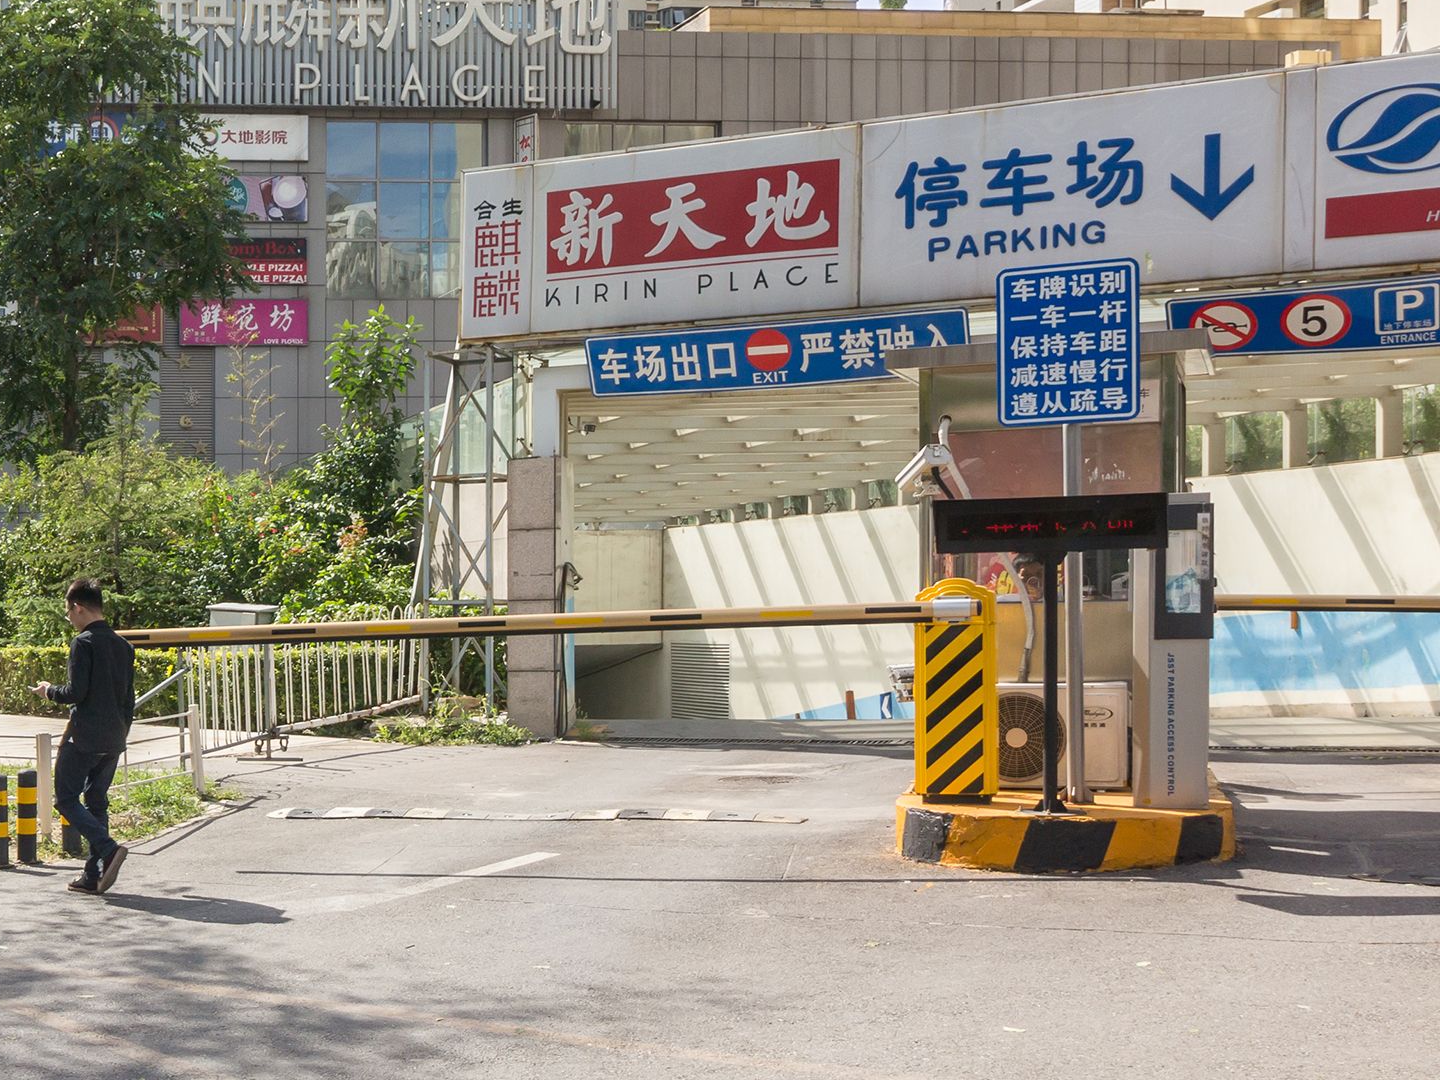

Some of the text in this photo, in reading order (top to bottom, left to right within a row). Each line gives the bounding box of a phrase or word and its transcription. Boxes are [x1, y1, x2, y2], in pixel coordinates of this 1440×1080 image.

[294, 62, 547, 103] PLACE
[221, 129, 288, 145] 大地影院
[895, 137, 1143, 230] 停车场
[474, 197, 524, 220] 合生
[549, 170, 830, 266] 新天地
[927, 220, 1106, 262] PARKING
[268, 263, 304, 273] PIZZA!
[272, 274, 307, 284] PIZZA!
[473, 219, 521, 318] 麒麟
[545, 262, 839, 308] KIRIN PLACE
[1010, 269, 1126, 302] 车牌识别
[199, 302, 296, 334] 鲜花坊
[1010, 300, 1127, 328] 一车一杆
[1300, 305, 1327, 337] 5
[1383, 319, 1433, 331] 地下停车场
[1010, 329, 1127, 359] 保持车距
[1380, 331, 1437, 345] ENTRANCE
[598, 341, 737, 385] 车场出口
[752, 370, 789, 385] EXIT
[1010, 357, 1128, 388] 减速慢行
[1011, 387, 1128, 416] 遵从疏导
[1167, 652, 1175, 797] JSST PARKING ACCESS CONTROL
